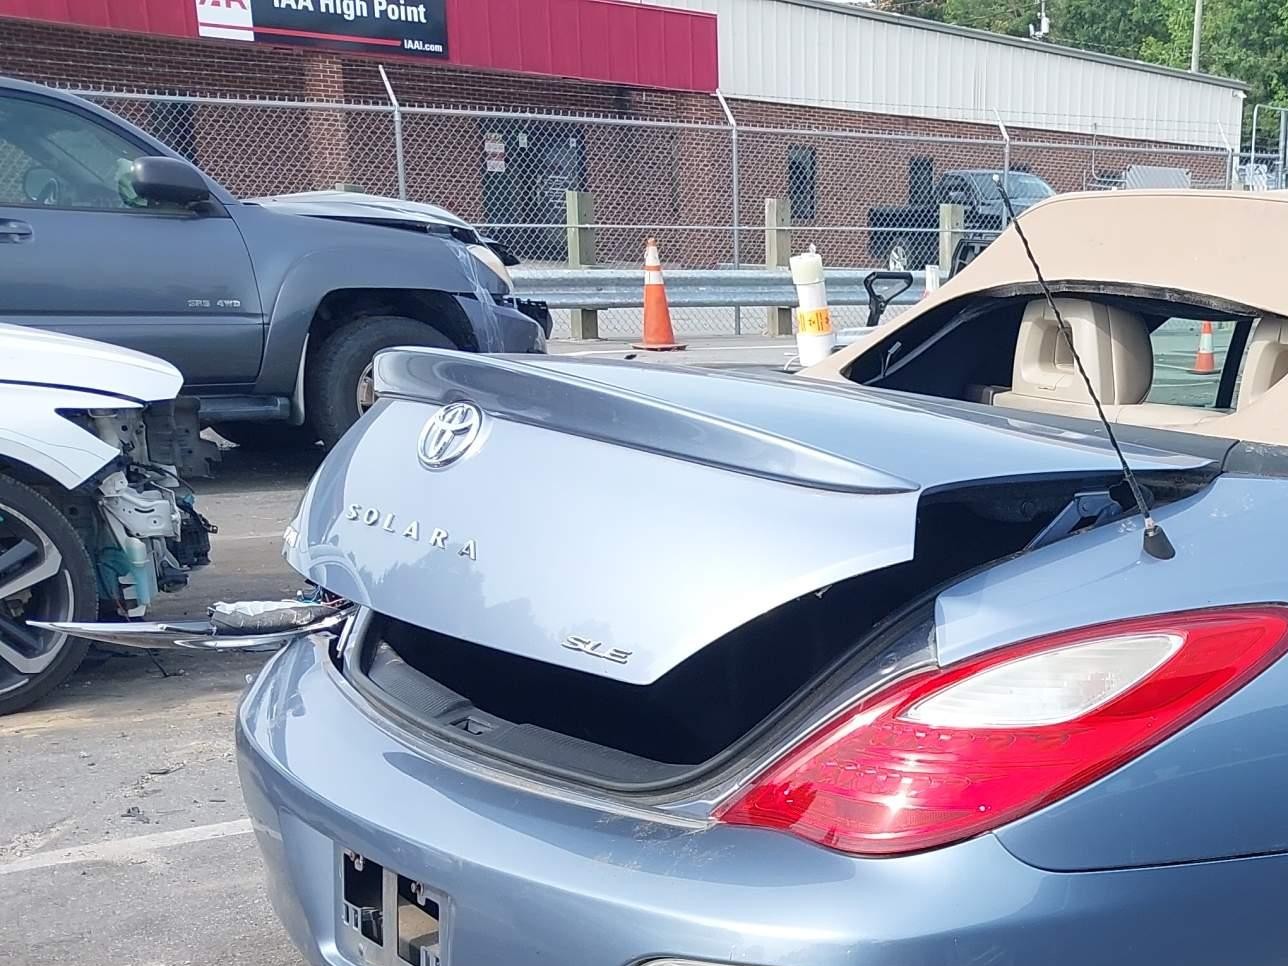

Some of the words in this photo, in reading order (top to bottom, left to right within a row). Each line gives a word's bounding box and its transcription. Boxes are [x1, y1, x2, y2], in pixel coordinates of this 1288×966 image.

[320, 0, 367, 20] High
[374, 0, 427, 23] Point
[403, 39, 443, 53] IAAI.com
[346, 503, 477, 561] SOLARA
[560, 635, 633, 665] SLE
